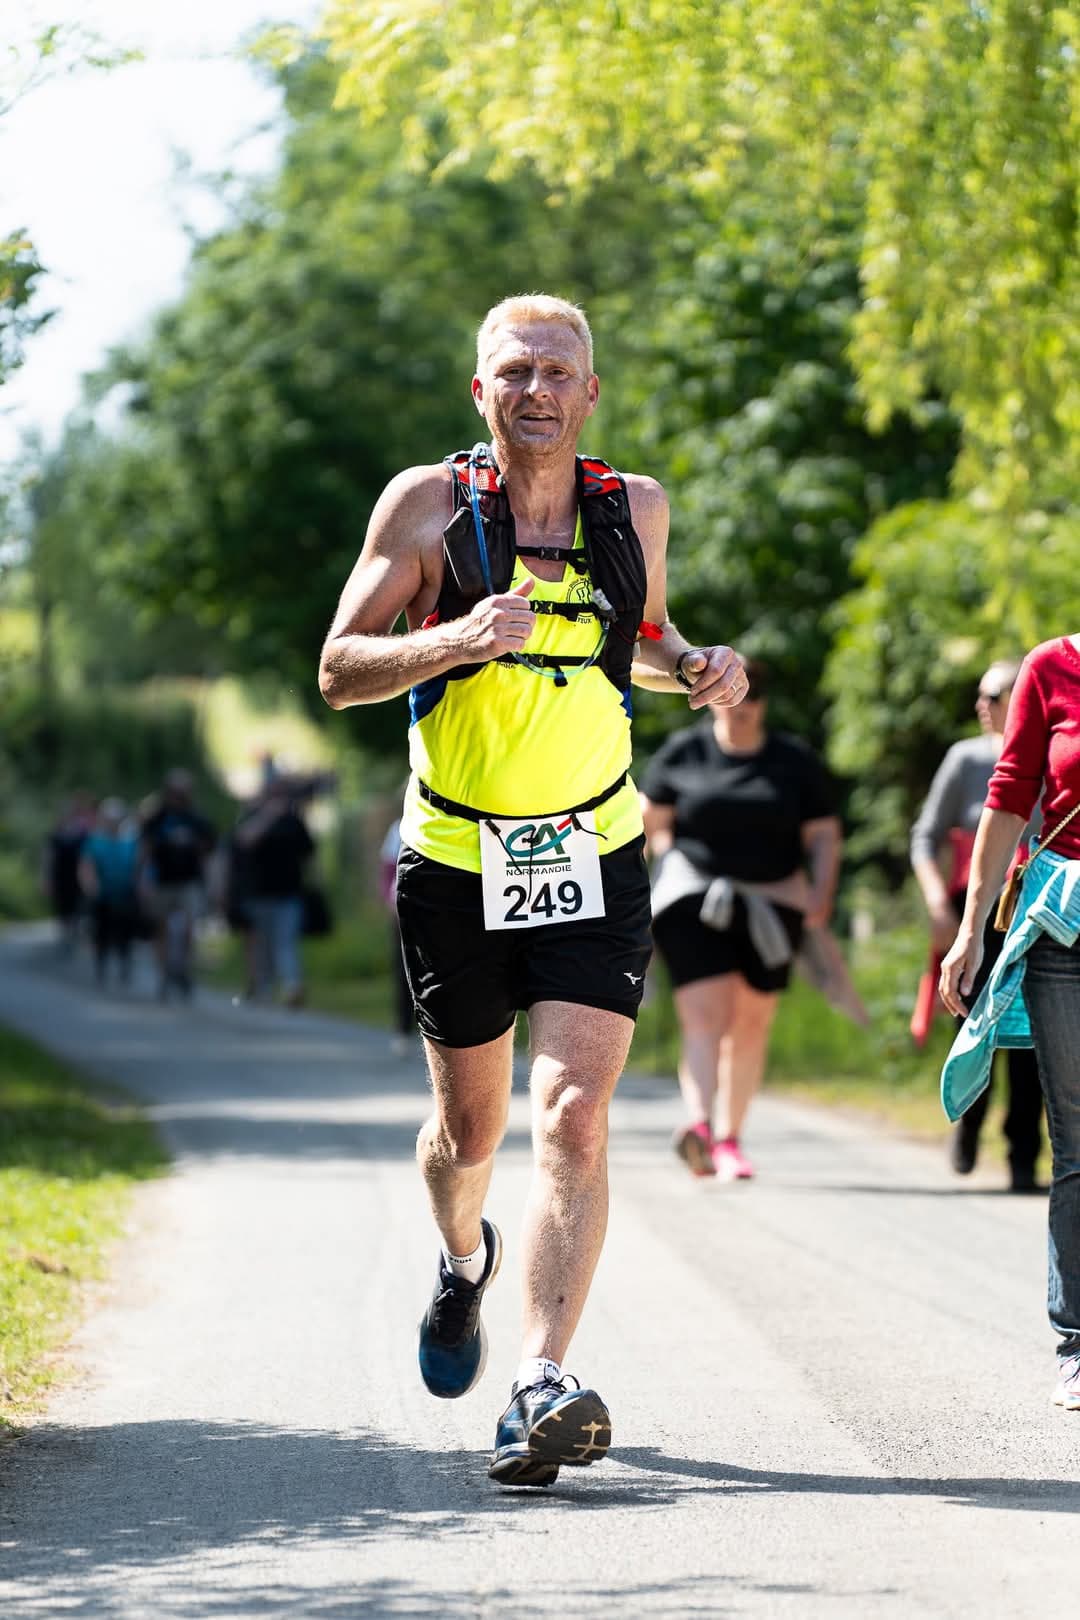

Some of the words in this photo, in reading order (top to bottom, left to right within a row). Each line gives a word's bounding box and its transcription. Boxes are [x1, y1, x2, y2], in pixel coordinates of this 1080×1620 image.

[505, 822, 571, 858] CA
[506, 865, 572, 876] NORMANDIE
[503, 880, 583, 922] 249
